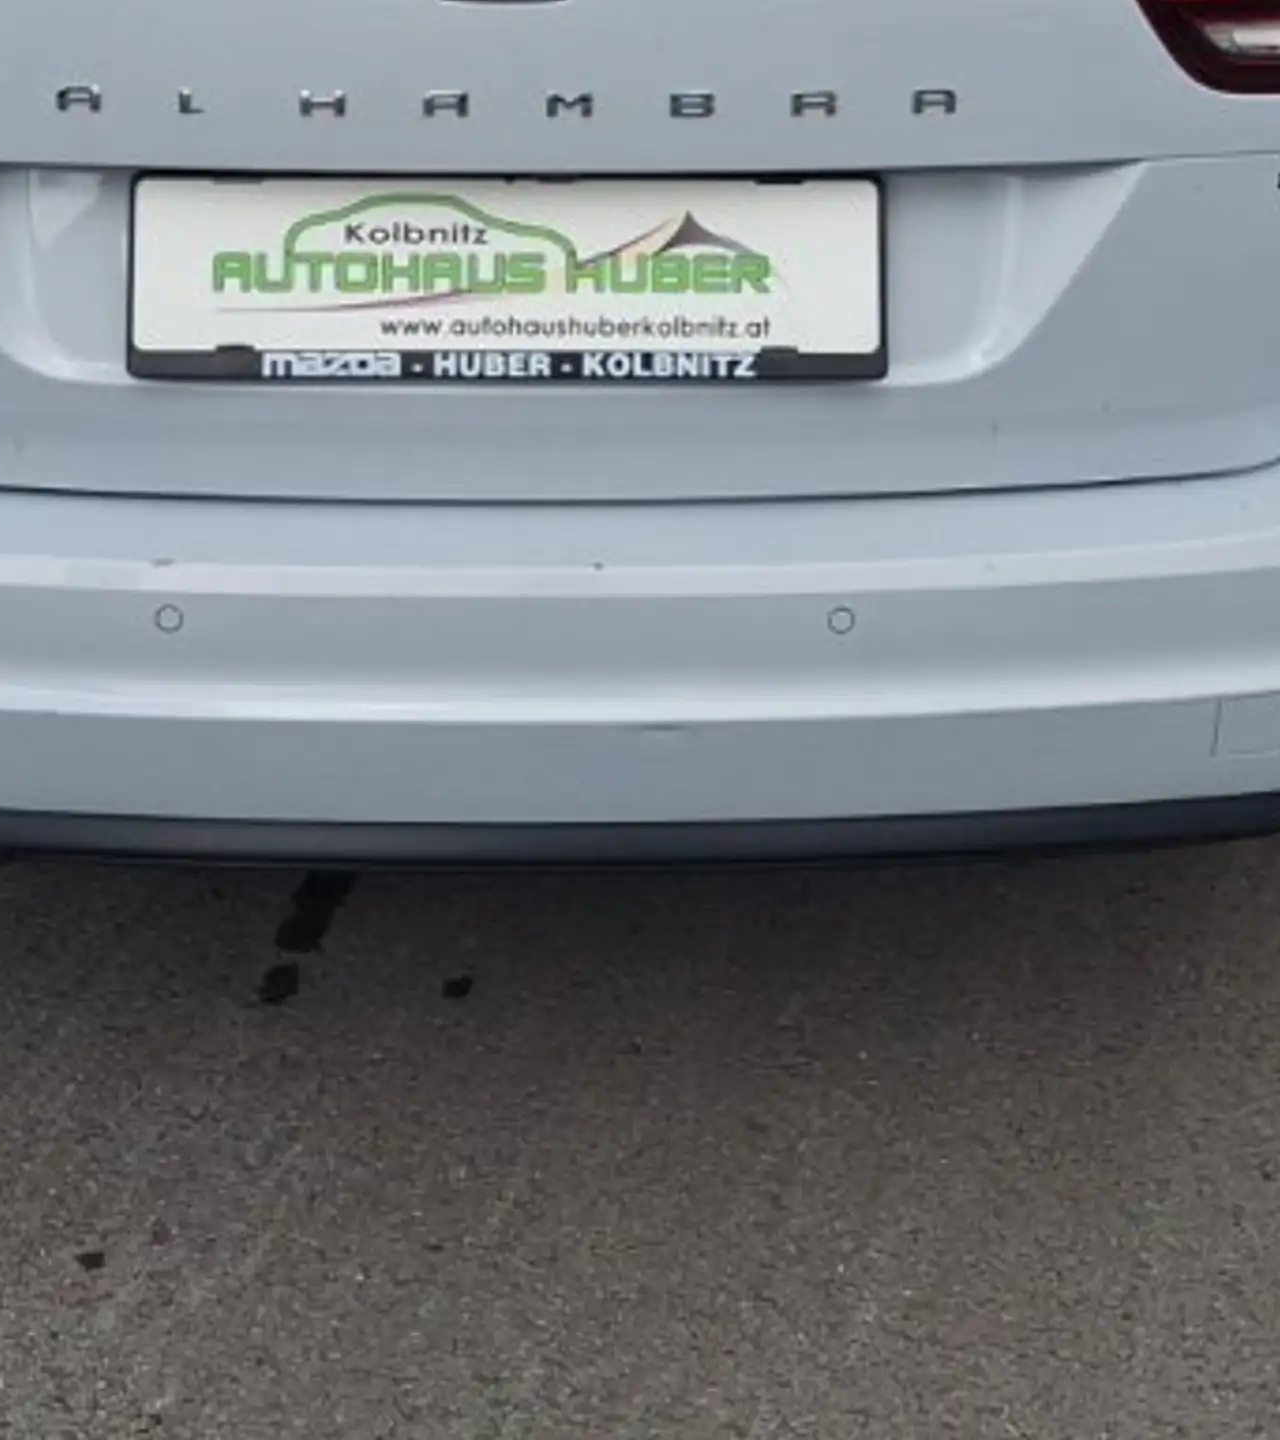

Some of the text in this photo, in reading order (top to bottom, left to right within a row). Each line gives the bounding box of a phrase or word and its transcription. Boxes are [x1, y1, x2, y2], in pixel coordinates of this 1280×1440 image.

[55, 85, 957, 119] ALHAMBRA
[343, 221, 490, 245] Kolbnitz
[212, 250, 772, 294] AUTOHAUS HUBER
[380, 316, 770, 339] www.autohaushuberkolbnitz.at
[432, 352, 552, 378] HUBER
[581, 352, 758, 378] KOLBNITZ
